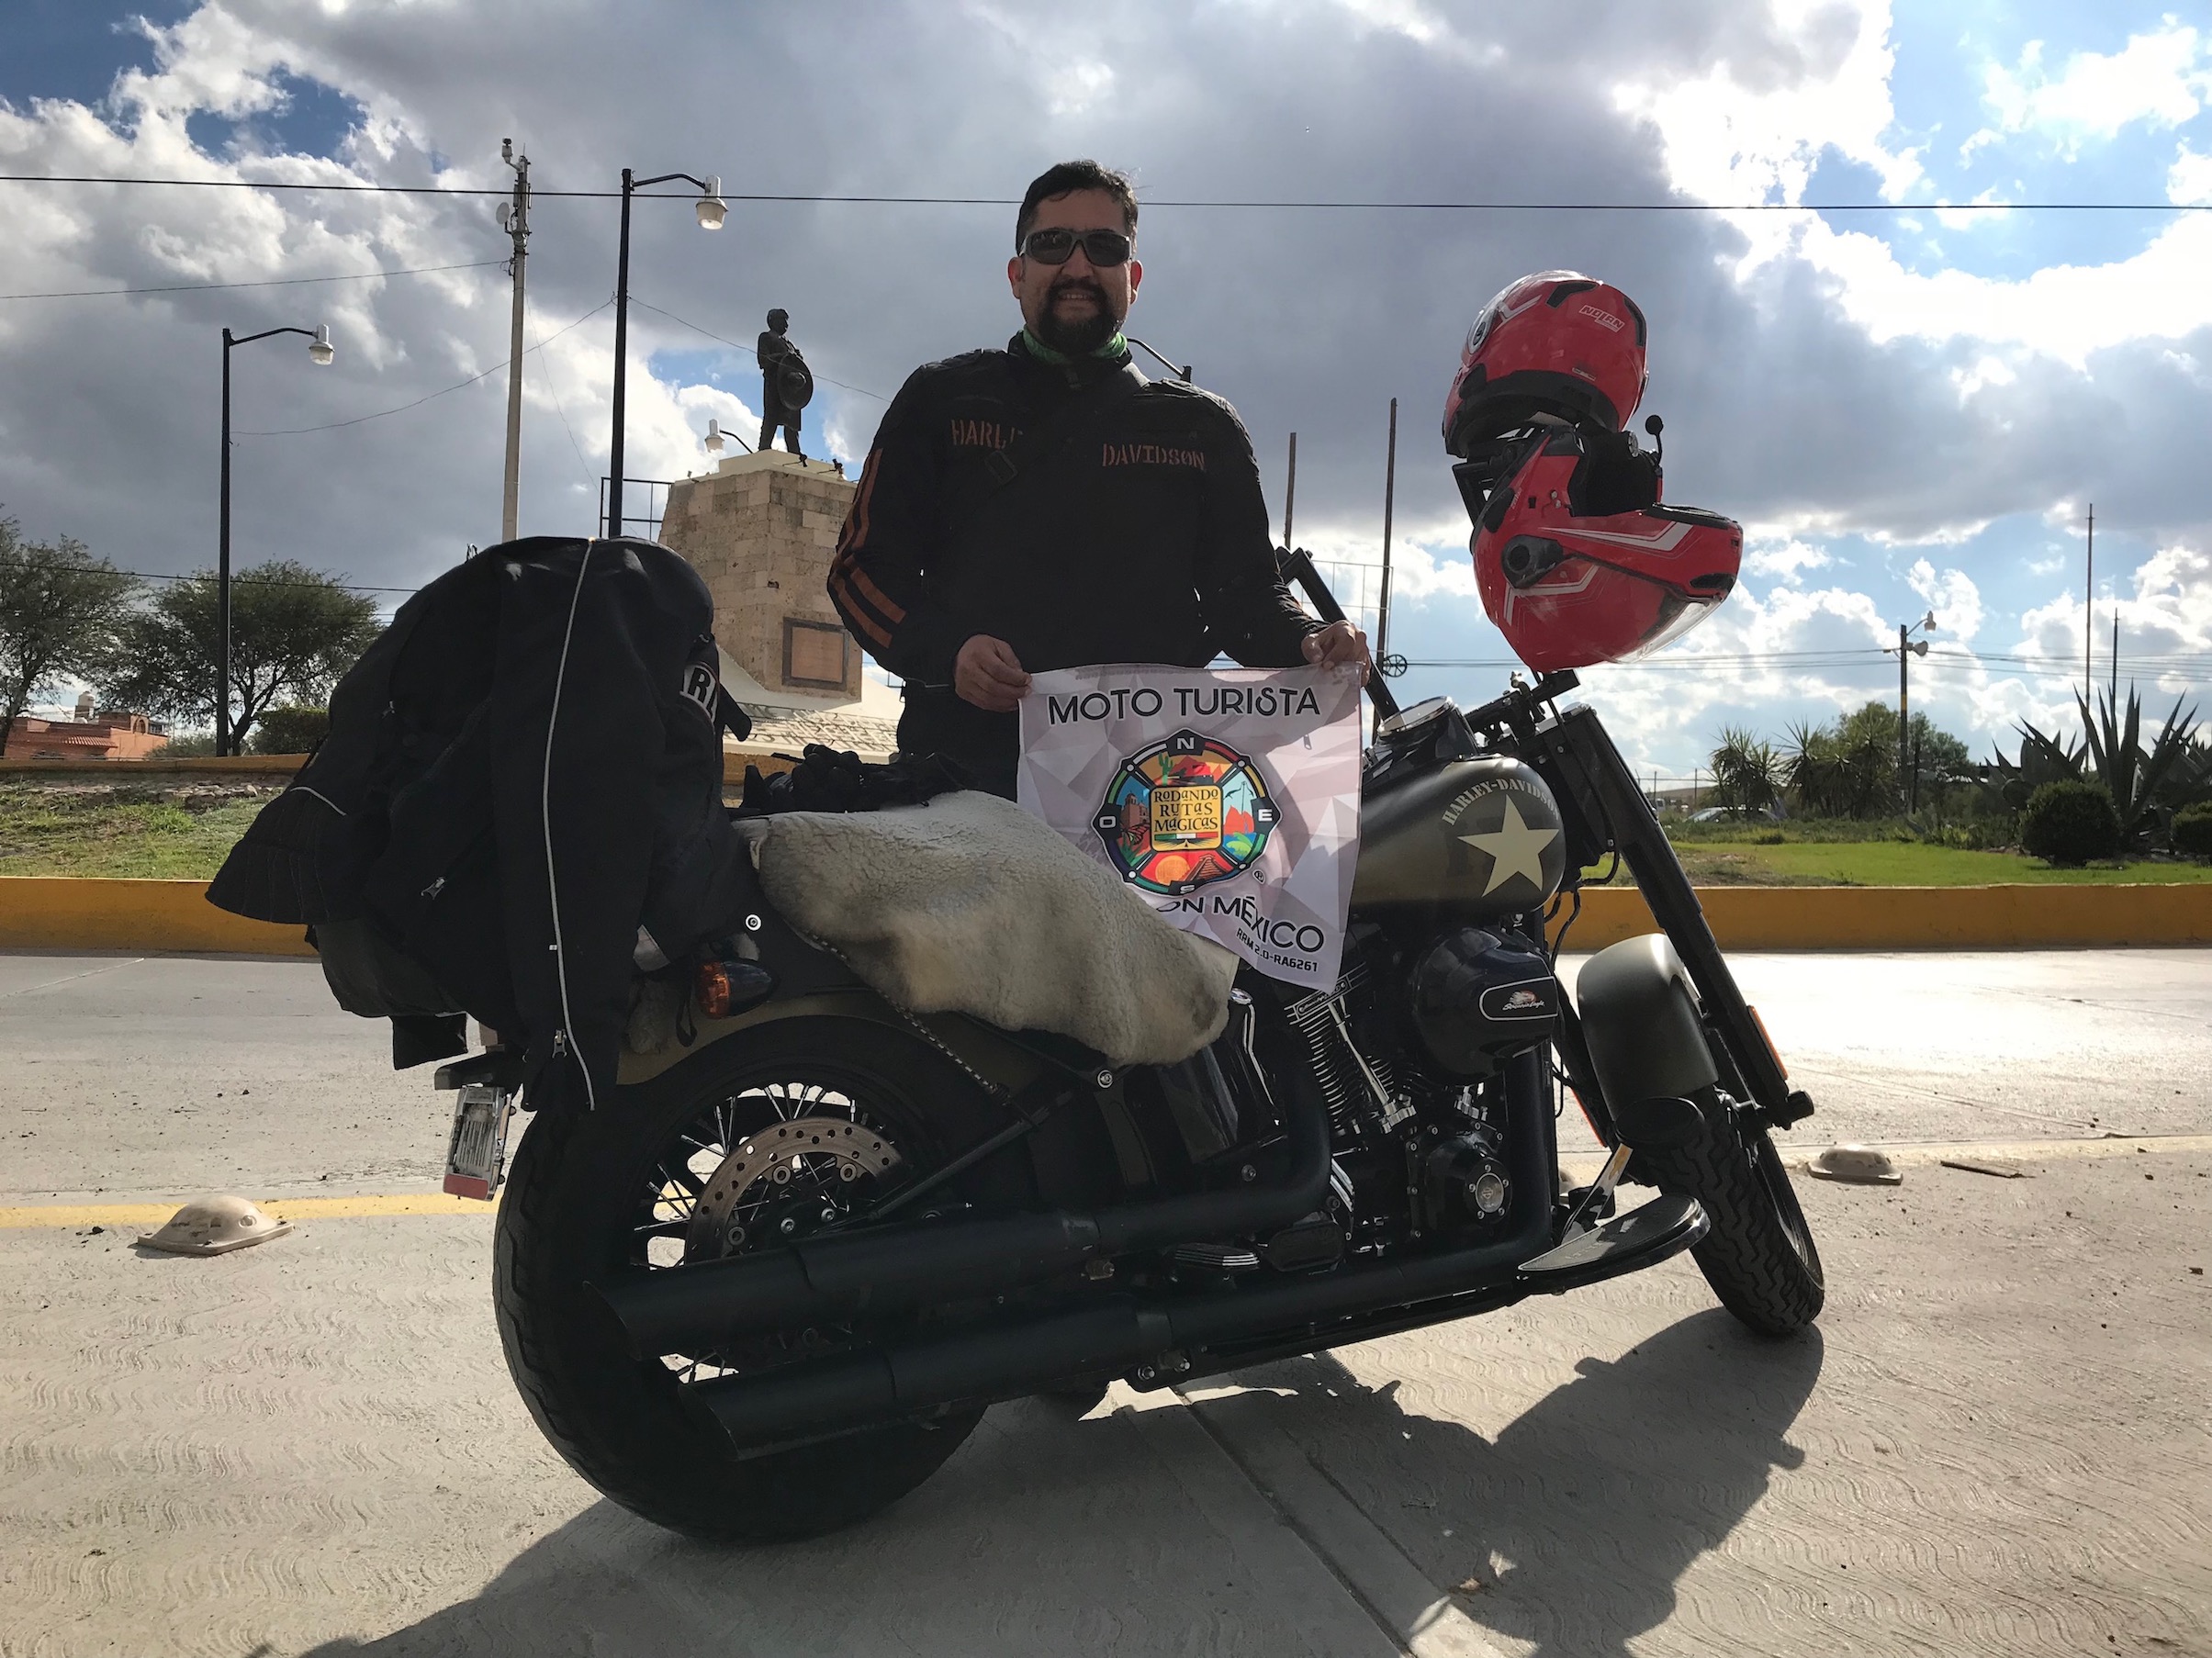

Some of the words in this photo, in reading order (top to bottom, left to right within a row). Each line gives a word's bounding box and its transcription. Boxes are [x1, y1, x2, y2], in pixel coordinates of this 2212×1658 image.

[1579, 305, 1624, 329] NOLAN
[1102, 443, 1207, 470] DAVIDSON
[1049, 689, 1162, 724] MOTO
[1173, 687, 1320, 716] TURISTA
[1177, 737, 1195, 749] N
[1258, 809, 1273, 822] E
[1442, 779, 1560, 826] HARLEY-DAVIDSON
[1213, 896, 1324, 952] MÉXICO
[1236, 928, 1254, 950] RRM
[1254, 944, 1318, 972] 2.0-RA6261
